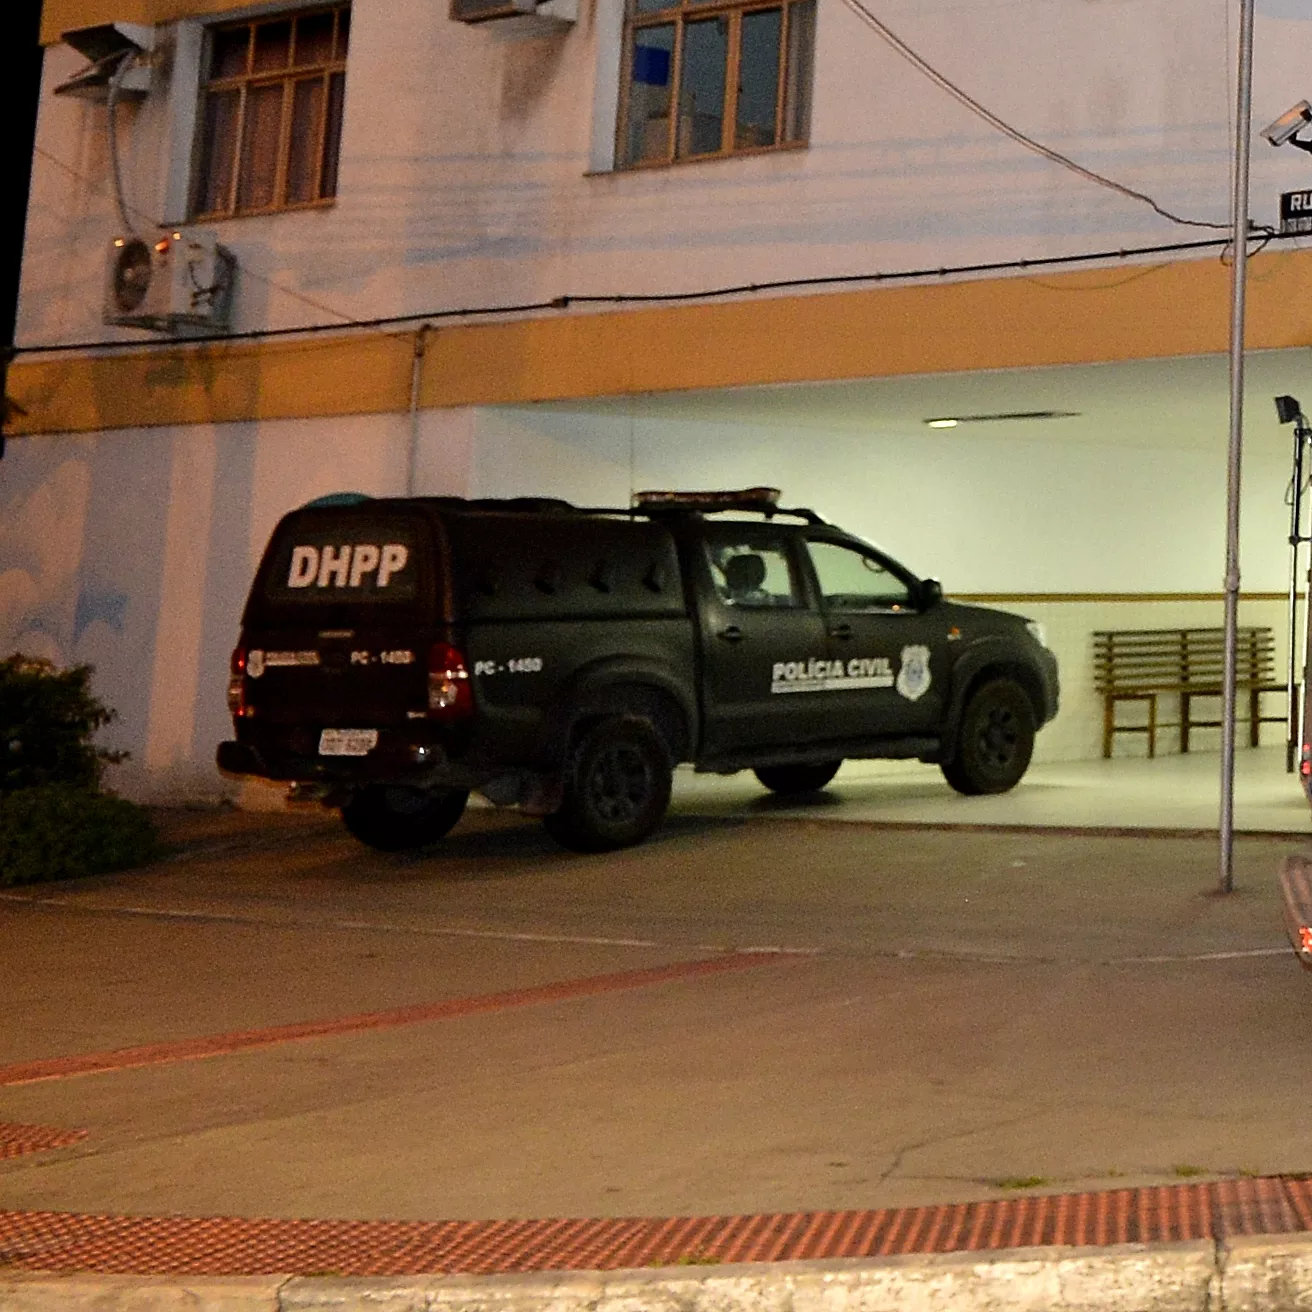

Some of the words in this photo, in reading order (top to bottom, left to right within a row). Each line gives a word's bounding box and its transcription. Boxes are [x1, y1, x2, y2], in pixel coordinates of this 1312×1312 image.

[287, 544, 409, 588] DHPP
[772, 657, 844, 680] POLÍCIA
[848, 658, 893, 677] CIVIL
